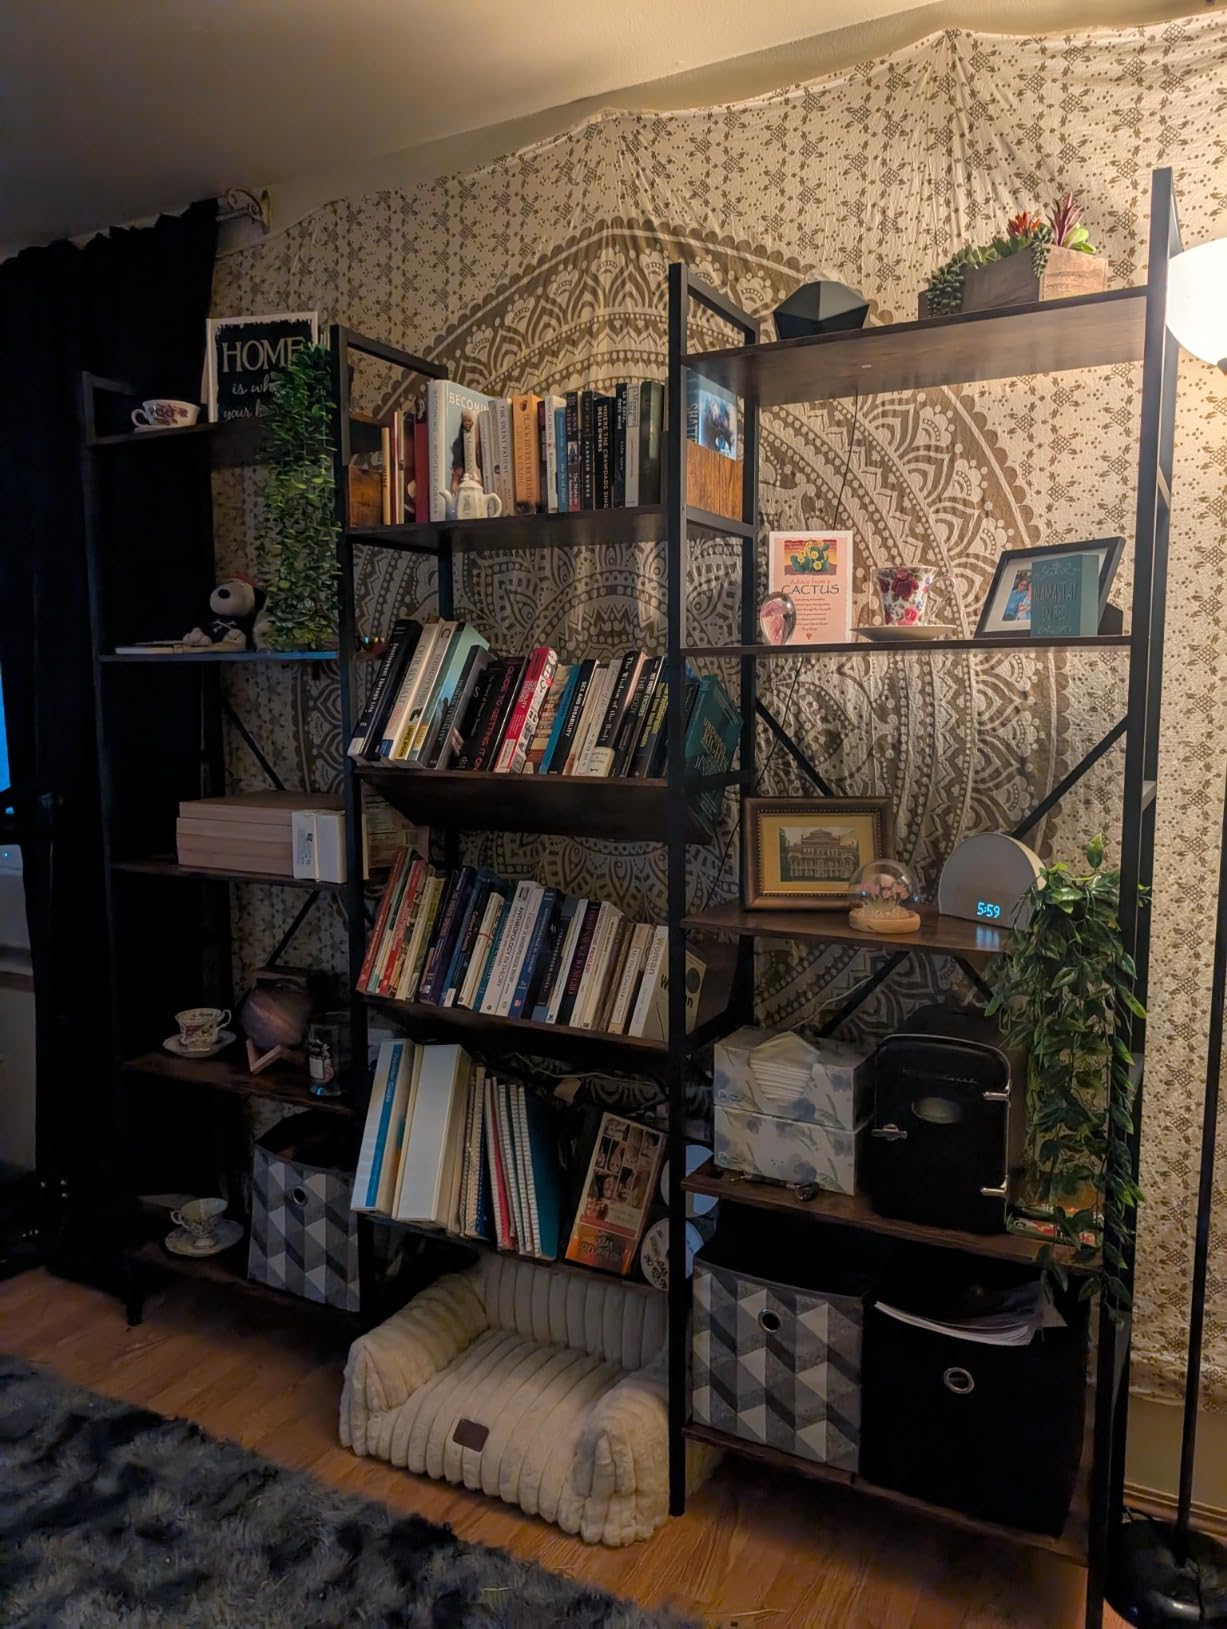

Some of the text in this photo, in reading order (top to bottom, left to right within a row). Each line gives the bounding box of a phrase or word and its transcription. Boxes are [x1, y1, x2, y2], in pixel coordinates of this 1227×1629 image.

[222, 336, 306, 373] HOME
[232, 380, 248, 395] is
[449, 391, 490, 413] BECOMIN
[223, 407, 252, 422] your
[431, 443, 440, 482] MICHELLE
[781, 584, 840, 595] CACTUS
[412, 643, 426, 666] OUR
[622, 654, 633, 670] The
[371, 676, 385, 701] Through
[614, 669, 629, 700] Wisdom
[636, 673, 647, 691] THE
[494, 692, 504, 707] TO
[563, 680, 587, 737] SEX AND DISABILITY
[628, 691, 641, 716] BODY
[480, 706, 500, 747] GETTING
[606, 708, 616, 722] the
[976, 901, 1001, 919] 5:59
[504, 905, 524, 956] ANTHROPOLOGY
[647, 935, 665, 976] Woman
[495, 962, 507, 988] THEORY
